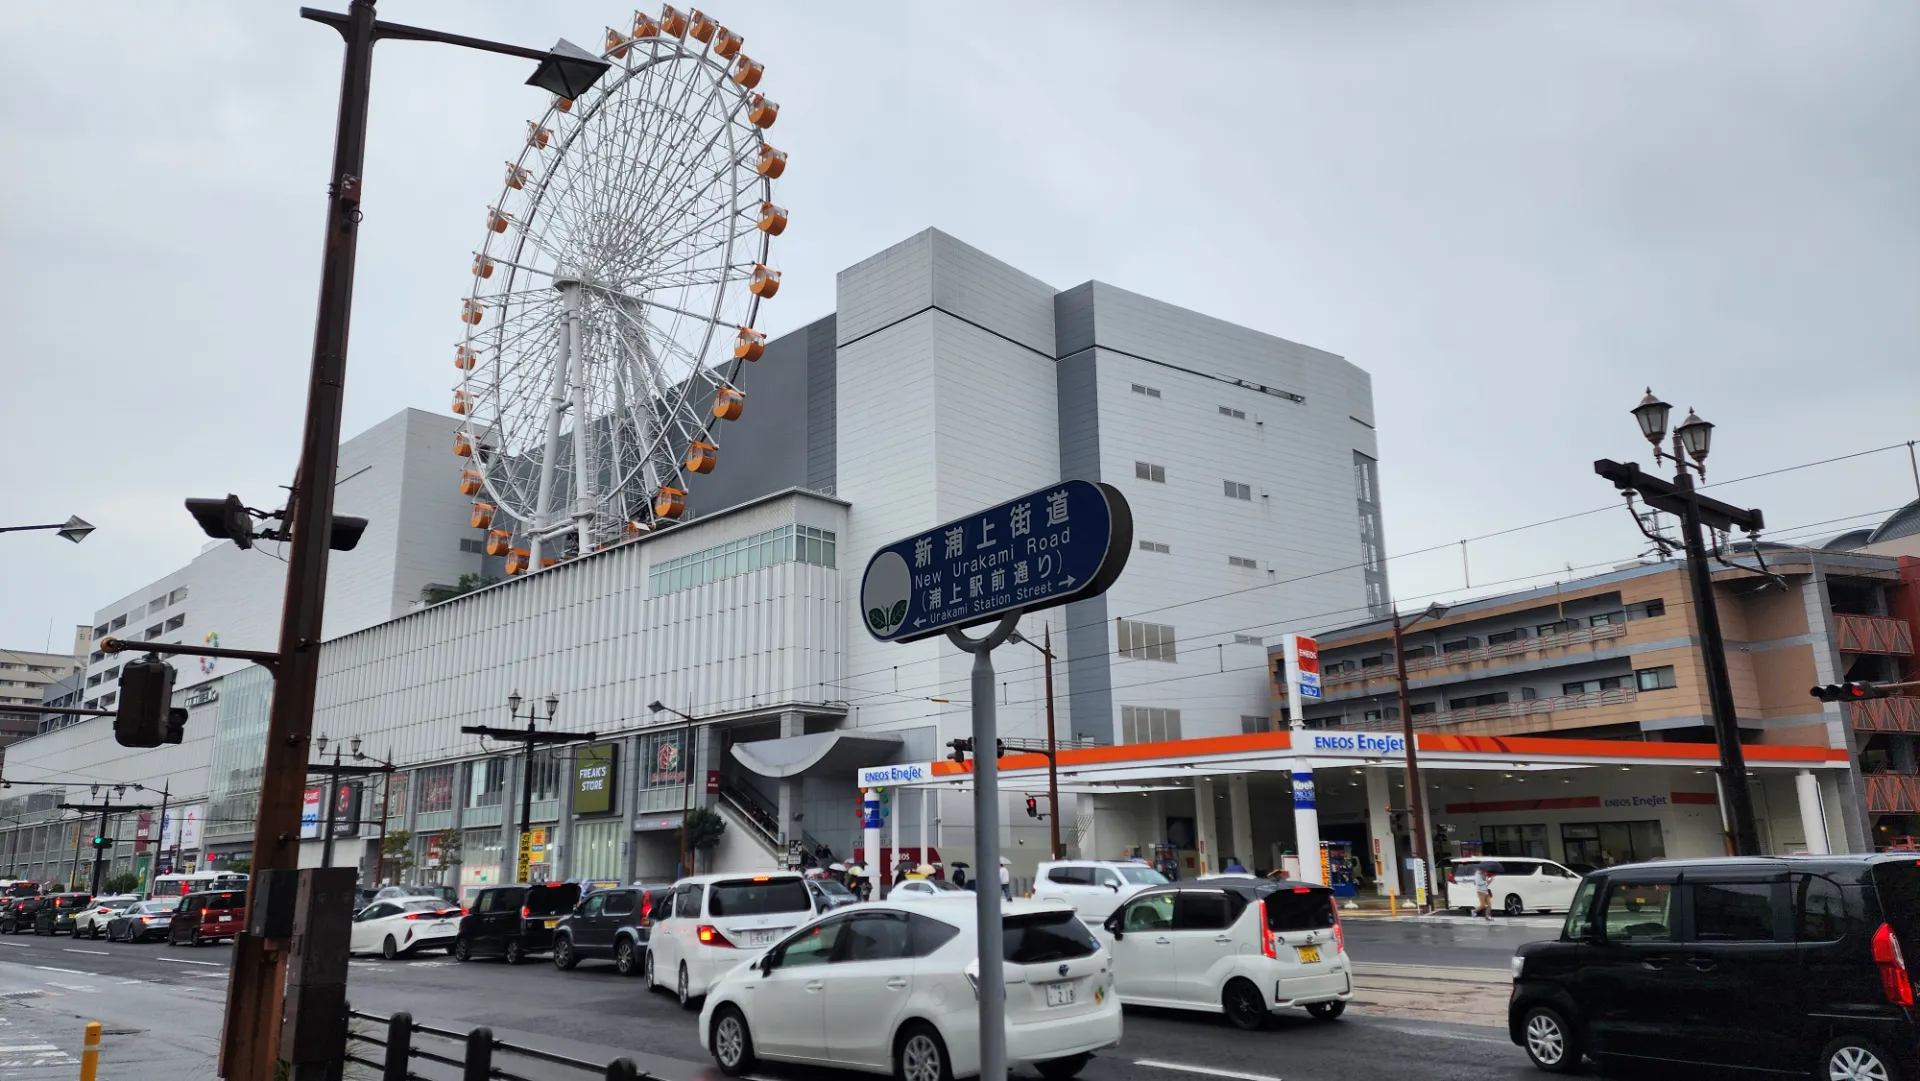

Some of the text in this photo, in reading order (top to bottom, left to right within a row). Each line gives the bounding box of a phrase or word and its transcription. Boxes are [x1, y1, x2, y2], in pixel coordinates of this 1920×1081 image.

[915, 489, 1070, 569] 新浦上街道
[915, 527, 1070, 590] New Urakami Road
[921, 549, 1063, 613] (浦上駅前通り)
[930, 582, 1052, 624] Urakami Station Street
[1298, 648, 1317, 659] ENEOS
[1315, 734, 1405, 754] ENEOS Enejet
[579, 766, 607, 780] FREAK'S
[865, 765, 922, 782] ENEOS Enejet
[581, 779, 604, 792] STORE
[1604, 795, 1667, 808] ENEOS Enejet
